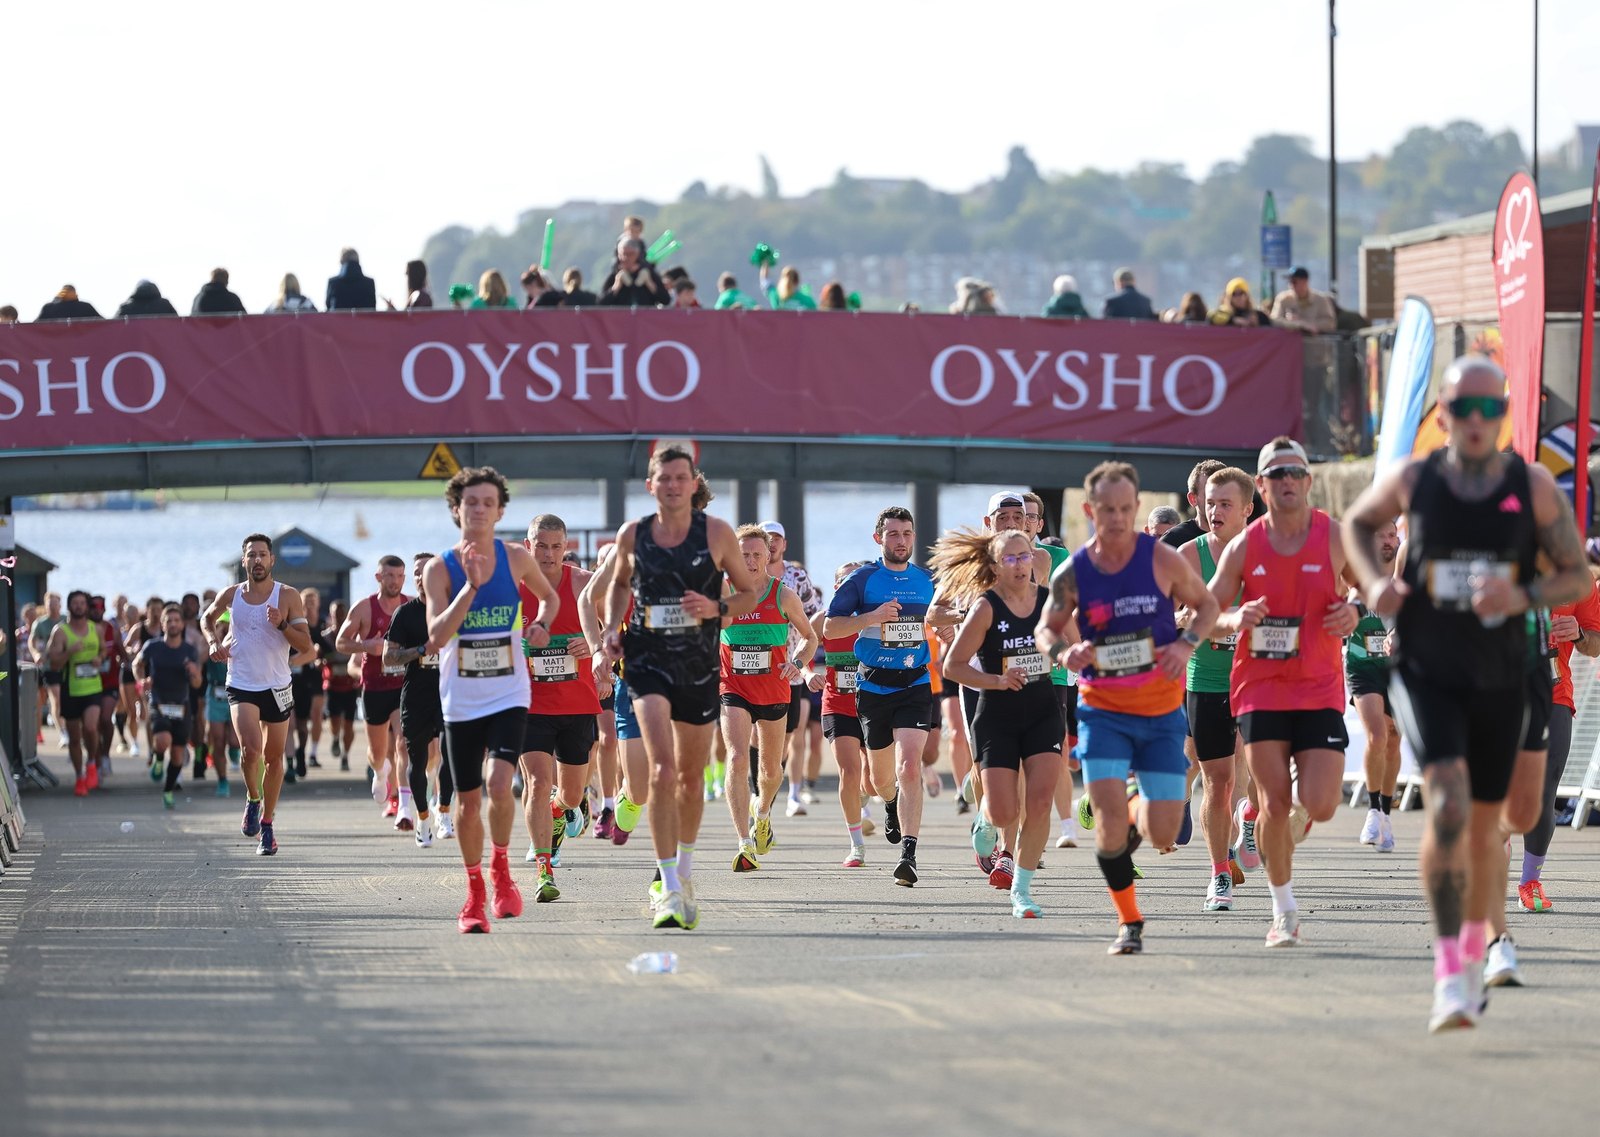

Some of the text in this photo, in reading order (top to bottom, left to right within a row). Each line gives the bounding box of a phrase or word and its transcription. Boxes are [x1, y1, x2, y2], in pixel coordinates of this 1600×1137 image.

[402, 341, 700, 403] OYSHO
[931, 343, 1227, 415] OYSHO
[491, 606, 513, 615] CITY
[739, 612, 761, 620] DAVE
[888, 624, 920, 632] NICOLAS
[898, 632, 913, 640] 993
[1262, 630, 1290, 639] SCOTT
[474, 649, 498, 659] FRED
[541, 648, 566, 656] OYSHO
[1017, 647, 1038, 655] OYSH
[542, 657, 566, 666] MATT
[741, 653, 760, 661] DAVE
[1015, 655, 1044, 666] SARAH
[741, 660, 760, 668] 5776
[544, 665, 566, 674] 5773
